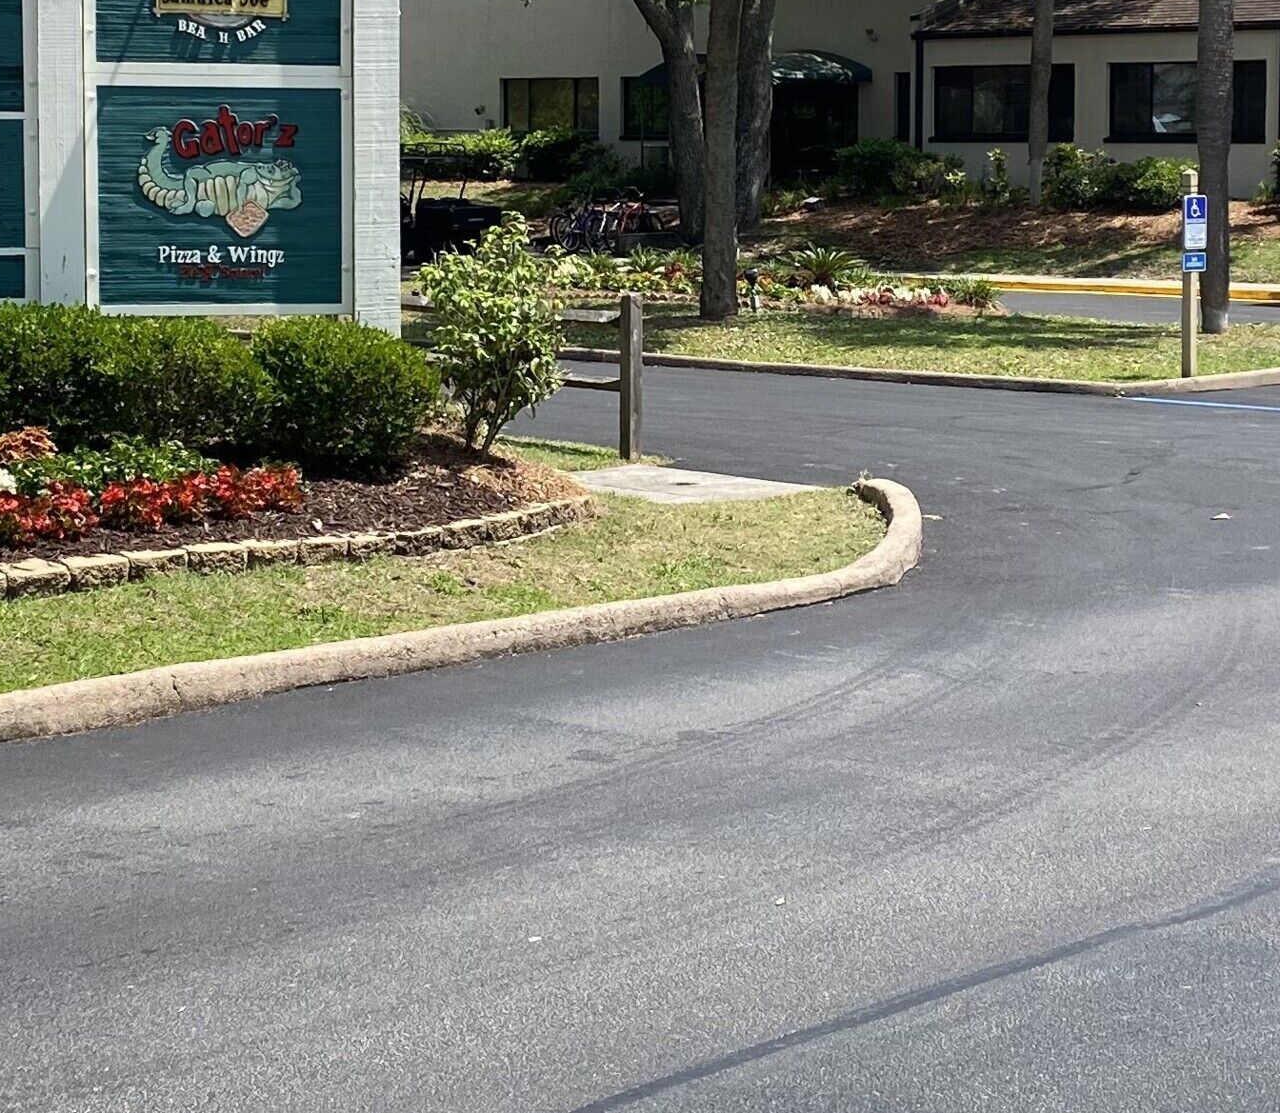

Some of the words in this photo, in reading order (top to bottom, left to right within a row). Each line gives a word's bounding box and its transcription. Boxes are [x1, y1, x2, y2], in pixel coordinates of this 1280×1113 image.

[236, 19, 266, 42] BAR
[158, 245, 201, 263] Pizza
[207, 245, 222, 264] &
[227, 245, 285, 267] Wingz
